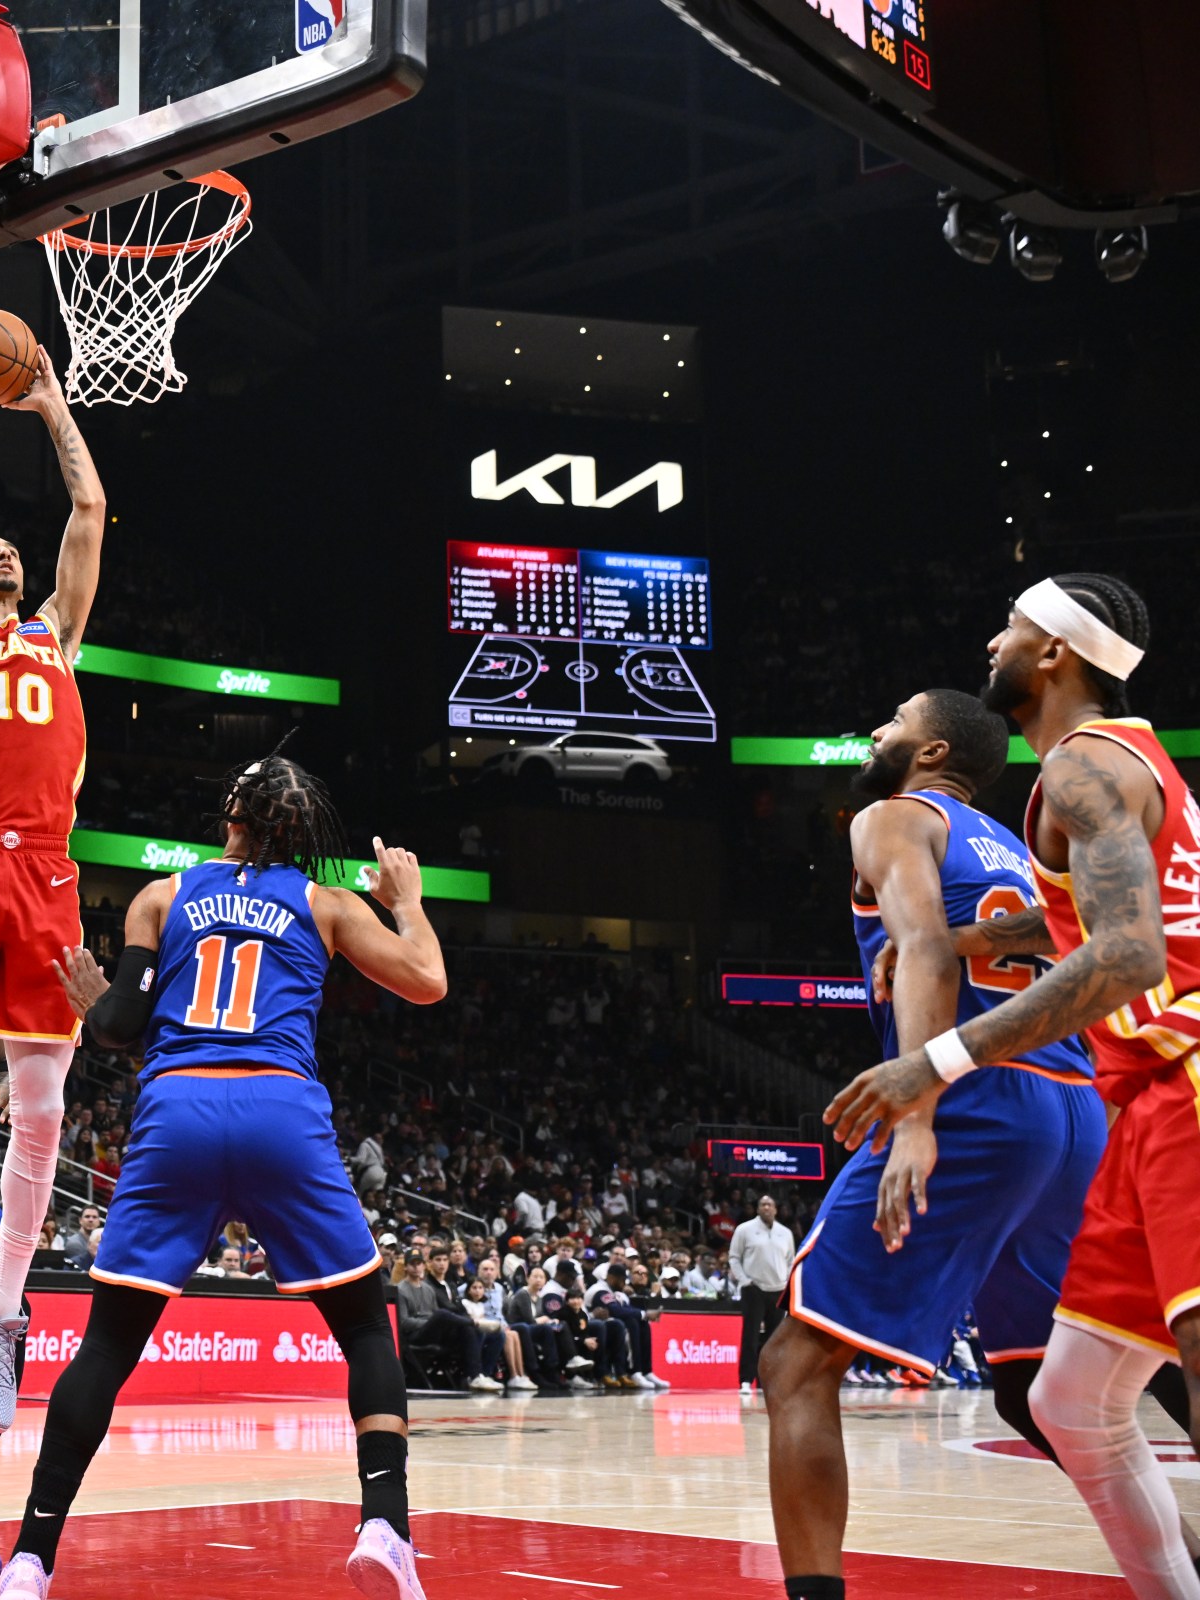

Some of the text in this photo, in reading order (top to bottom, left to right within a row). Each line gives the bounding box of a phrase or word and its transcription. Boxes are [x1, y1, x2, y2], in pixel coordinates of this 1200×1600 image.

[303, 20, 327, 47] NBA
[871, 29, 897, 65] 6:26
[911, 54, 925, 79] 15
[216, 669, 271, 694] Sprite
[559, 787, 664, 811] The Sorento
[141, 842, 200, 871] Sprite
[966, 836, 1035, 890] BRIDGE
[182, 893, 295, 938] BRUNSON
[184, 934, 264, 1034] 11
